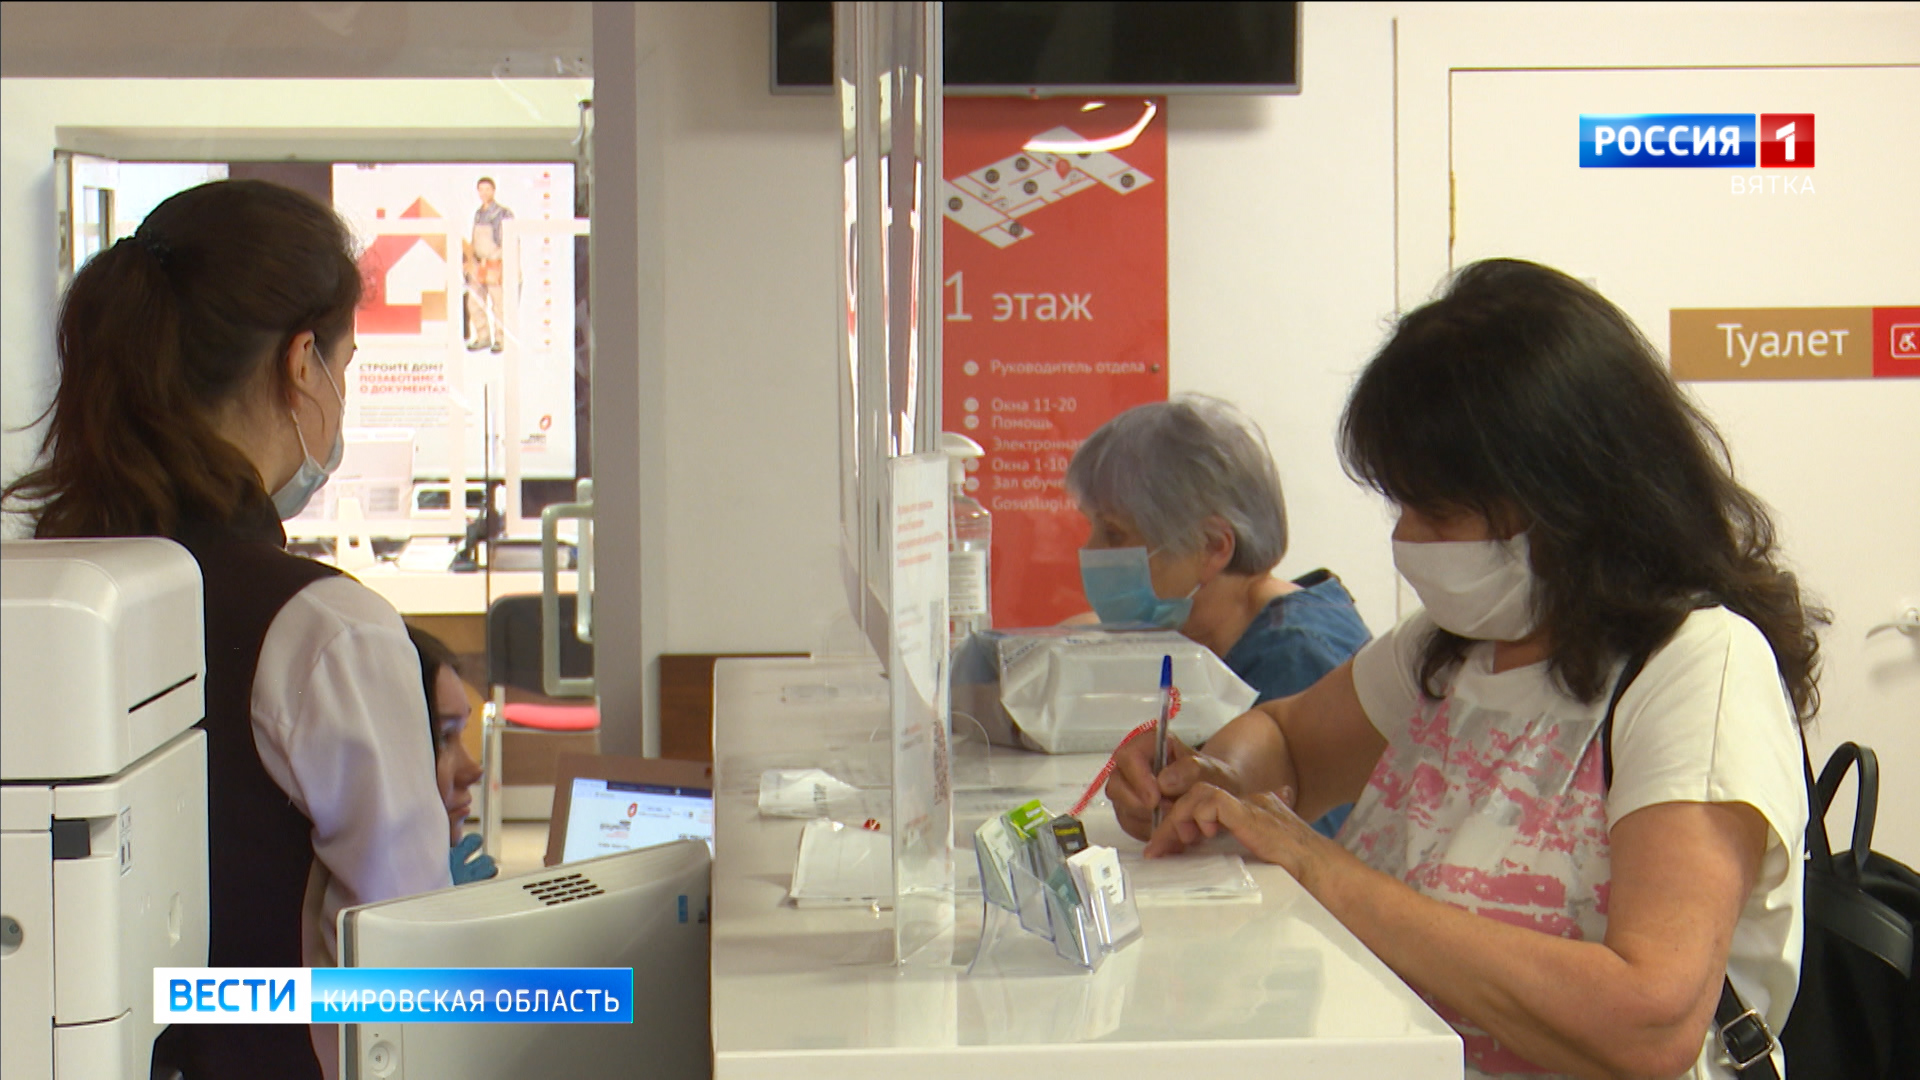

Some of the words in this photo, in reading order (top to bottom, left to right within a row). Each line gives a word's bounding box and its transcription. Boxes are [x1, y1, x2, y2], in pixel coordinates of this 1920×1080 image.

[944, 270, 973, 321] 1
[992, 292, 1093, 321] этаж
[1715, 322, 1850, 367] Туалет
[991, 359, 1093, 377] Руководитель
[1096, 361, 1146, 375] отдела
[991, 397, 1029, 412] Окна
[1033, 397, 1077, 412] 11-20
[991, 415, 1053, 431] Помощь
[991, 457, 1029, 472] Окна
[1034, 456, 1068, 472] 1-10
[992, 475, 1019, 490] Зал
[1022, 475, 1067, 493] обуче
